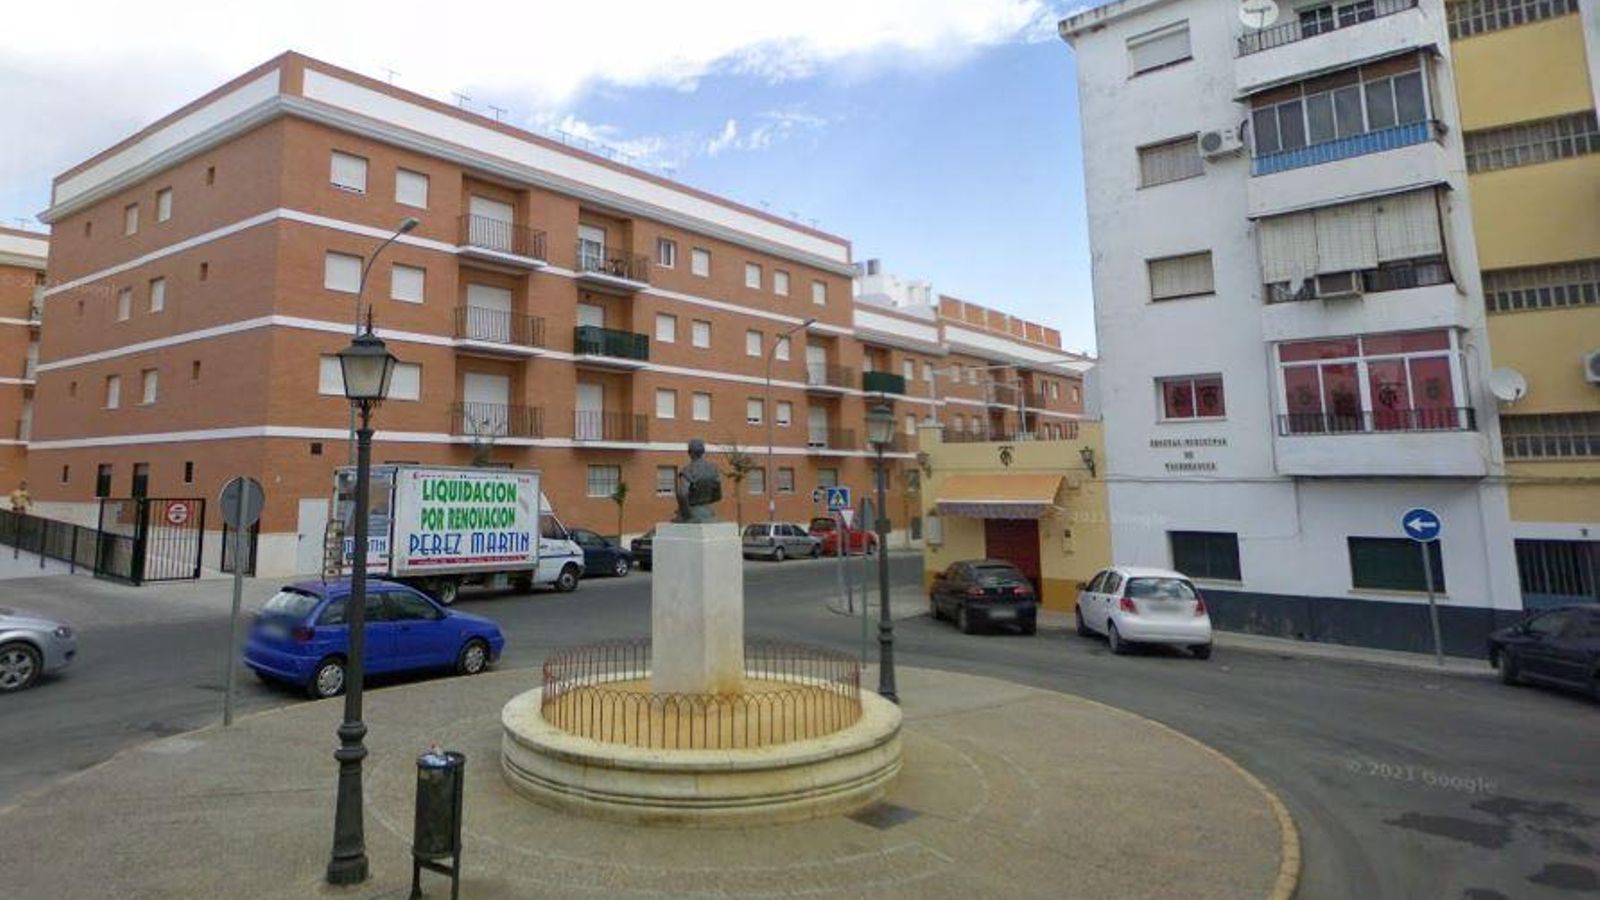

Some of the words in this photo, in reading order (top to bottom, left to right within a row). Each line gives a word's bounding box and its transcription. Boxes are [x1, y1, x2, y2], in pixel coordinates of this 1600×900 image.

[422, 479, 517, 503] LIQUIDACION
[420, 507, 444, 530] POR
[447, 507, 516, 530] RENOVACION
[408, 533, 462, 556] PEREZ
[470, 532, 530, 553] MARTIN
